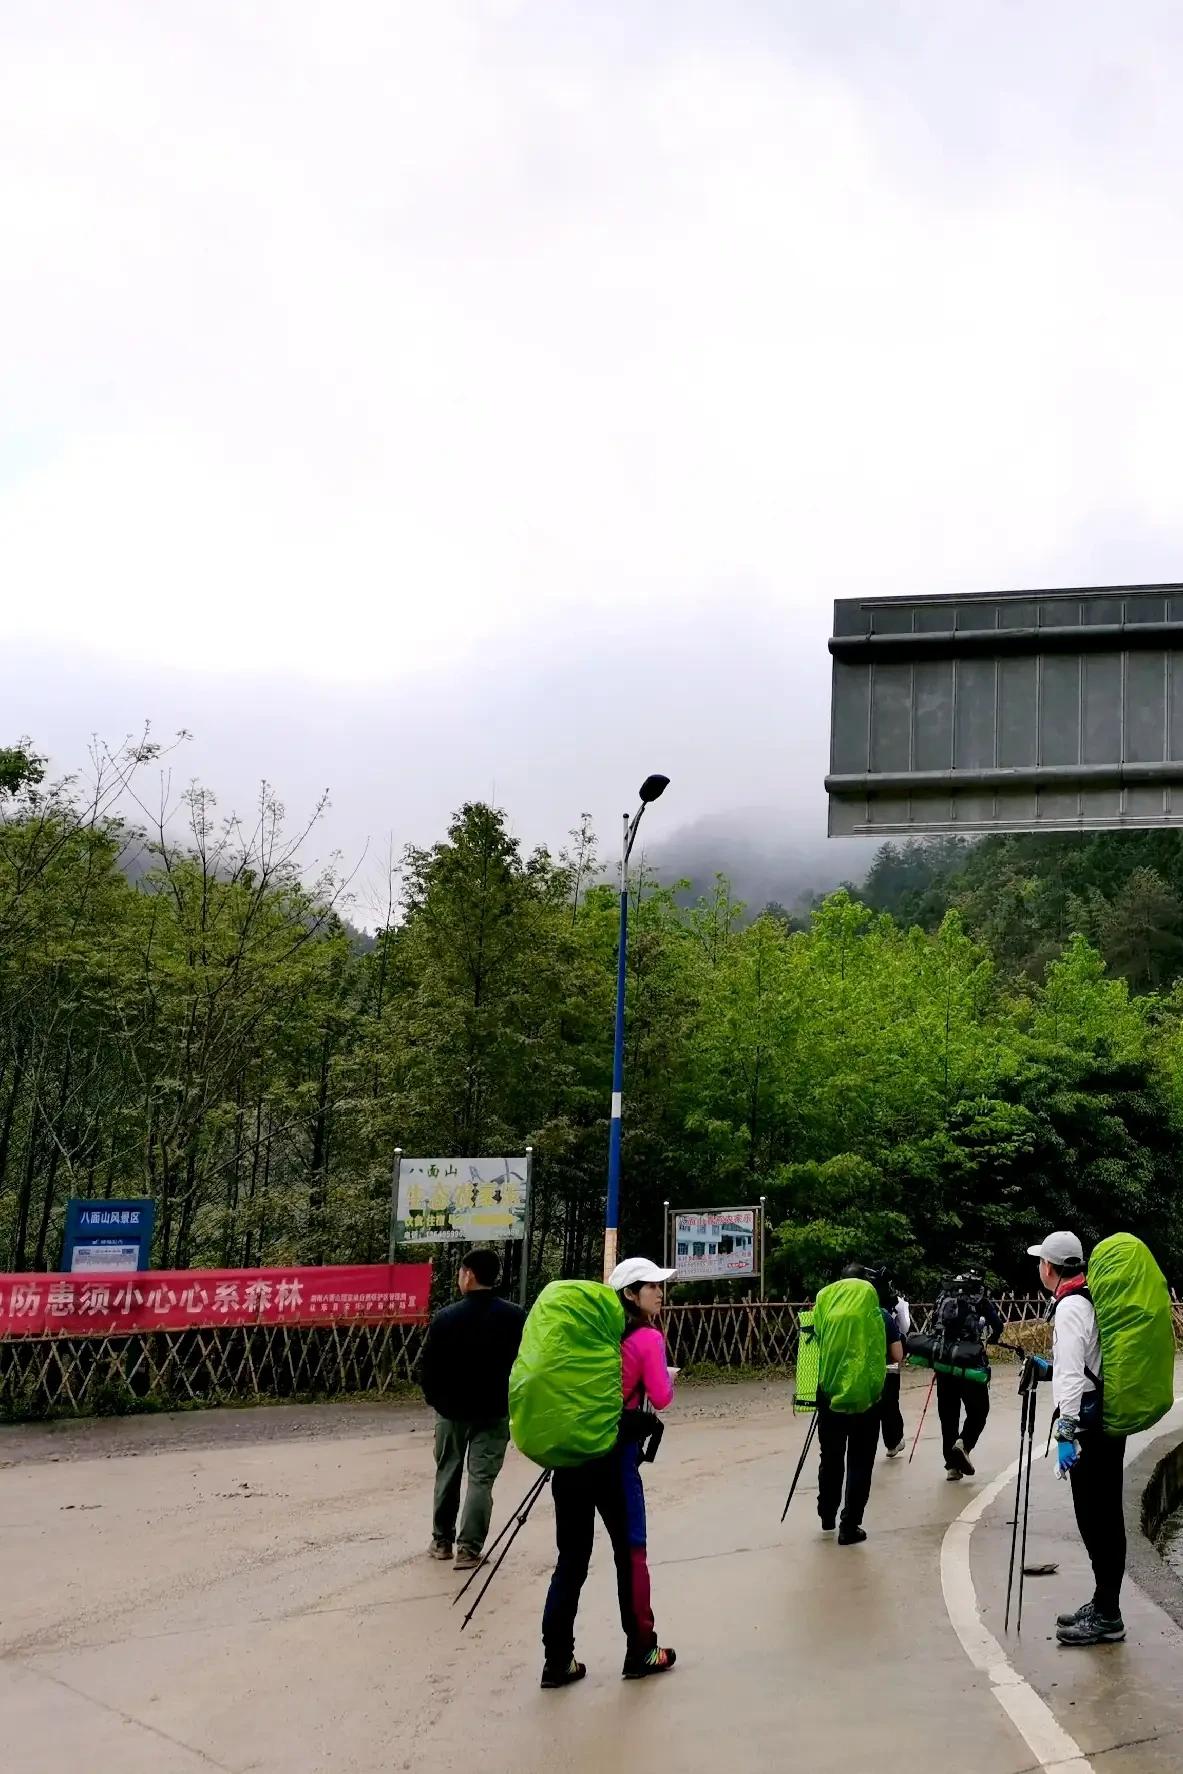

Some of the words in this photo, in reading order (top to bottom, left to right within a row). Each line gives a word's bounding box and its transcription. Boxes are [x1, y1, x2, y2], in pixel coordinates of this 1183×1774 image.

[80, 1211, 140, 1224] 八面山风景区
[0, 1278, 304, 1318] 防患须小心心系森林
